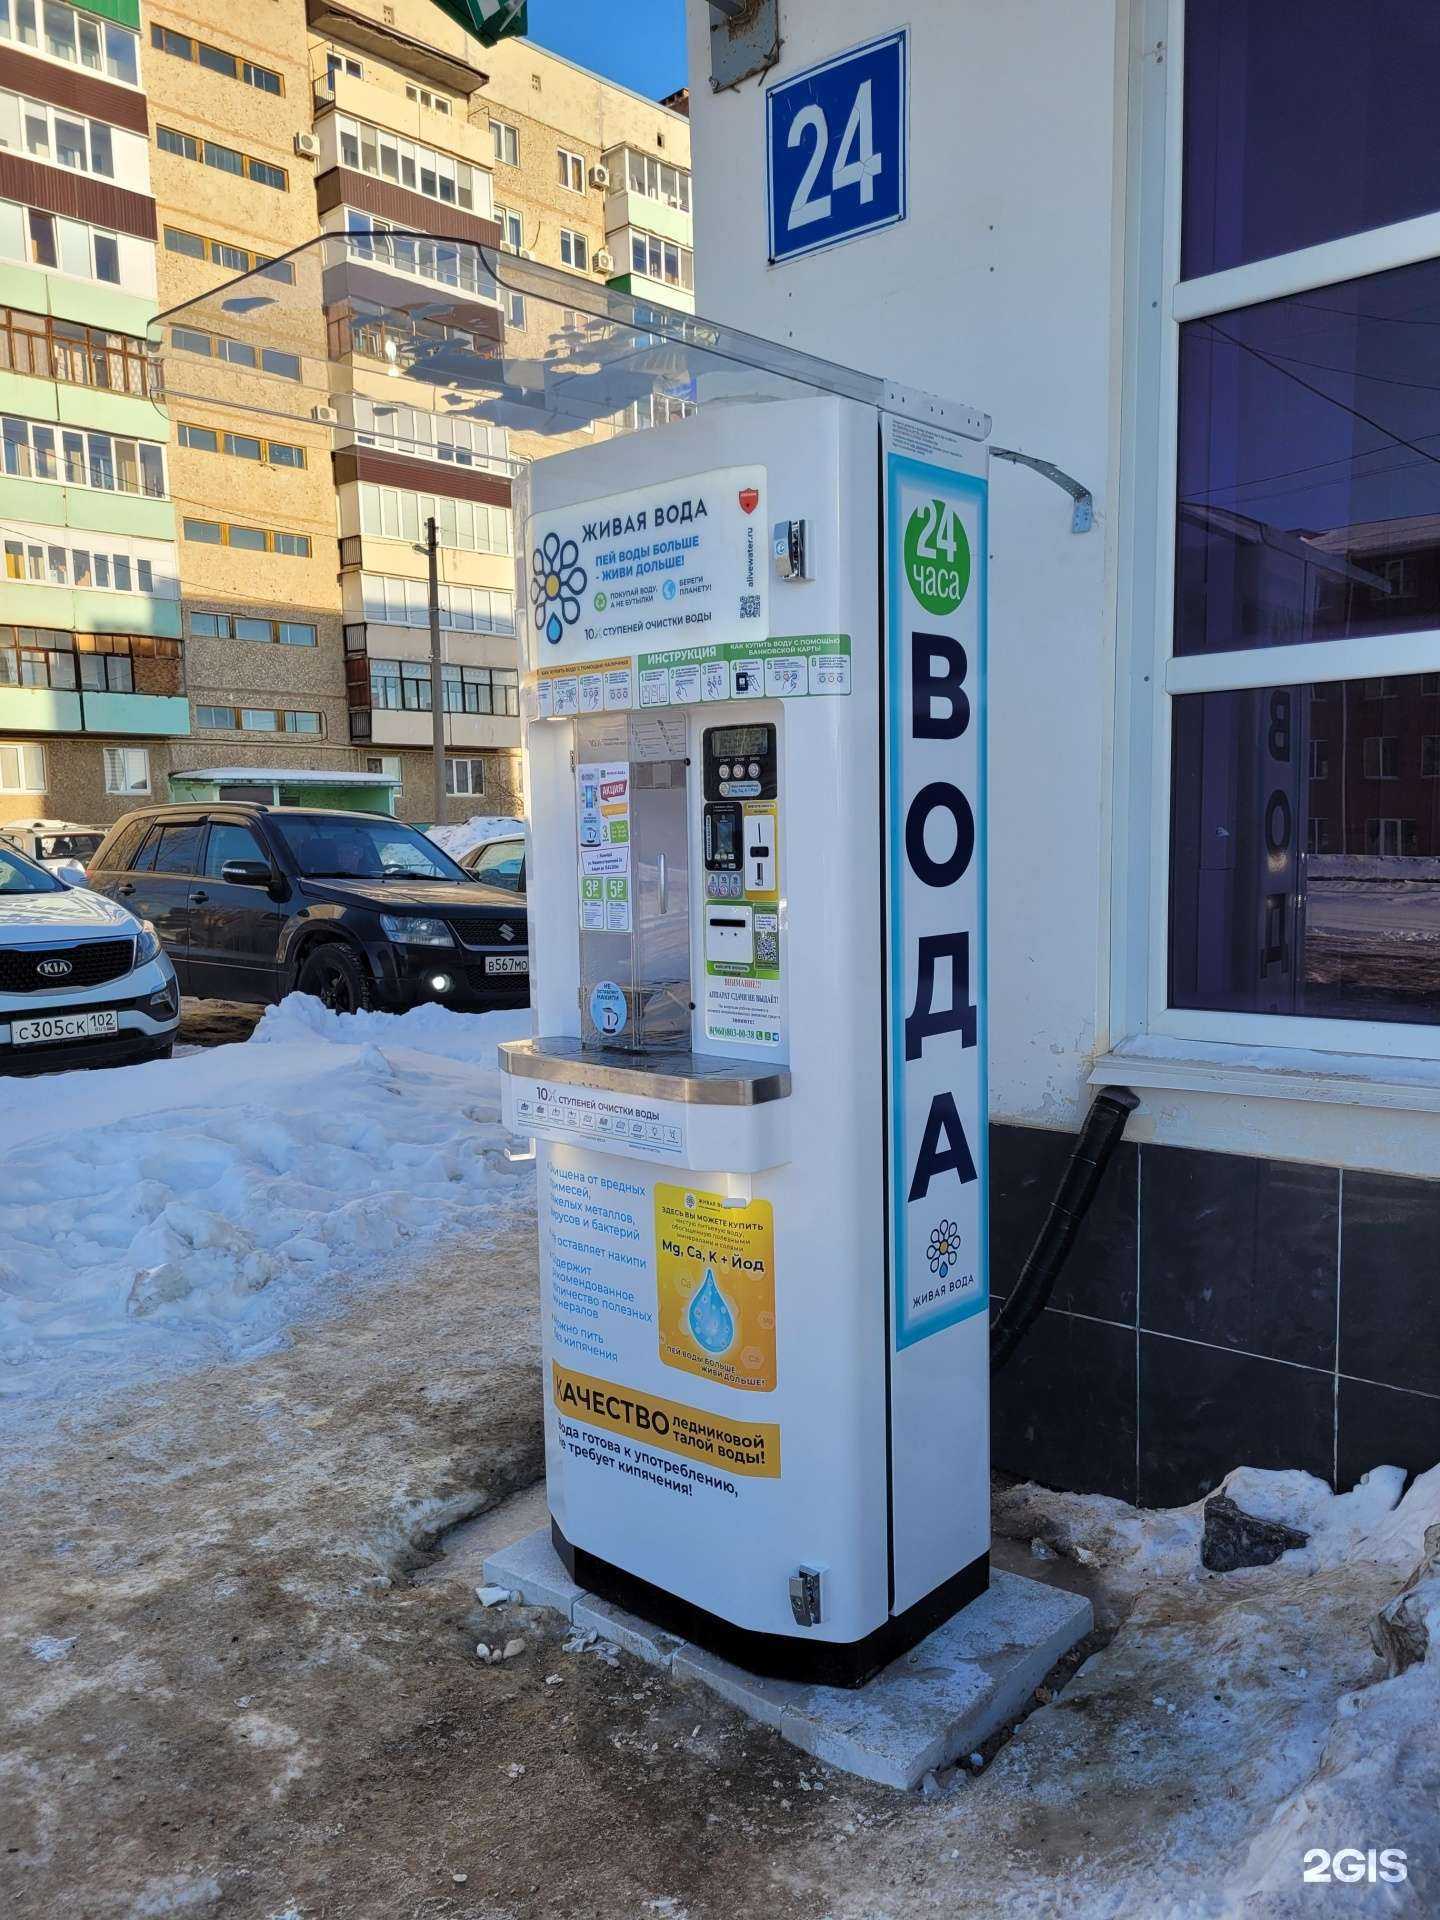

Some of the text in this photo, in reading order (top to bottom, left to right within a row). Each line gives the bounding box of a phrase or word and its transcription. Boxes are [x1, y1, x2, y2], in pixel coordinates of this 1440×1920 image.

[787, 78, 882, 232] 24
[582, 498, 708, 543] ЖИВАЯ ВОДА
[915, 499, 957, 563] 24
[595, 536, 700, 567] ПЕЙ ВОДЫ БОЛЬШЕ
[745, 527, 754, 588] alivewater.ru
[602, 567, 634, 582] ЖИВИ
[636, 556, 685, 577] ДОЛЬШЕ!
[679, 576, 704, 587] БЕРЕГИ
[913, 563, 961, 600] часа
[610, 588, 639, 600] ПОКУПАЙ
[617, 600, 624, 608] НЕ
[625, 595, 654, 607] БУТЫЛКИ
[679, 584, 712, 596] ПЛАНЕТУ!
[603, 622, 643, 637] СТУПЕНЕЙ
[645, 616, 684, 632] ОЧИСТКИ
[685, 612, 712, 624] ВОДЫ
[647, 646, 718, 665] ИНСТРУКЦИЯ
[745, 641, 772, 649] КУПИТЬ
[773, 640, 793, 648] ВОДУ
[800, 638, 841, 646] ПОМОЩЬЮ
[748, 645, 822, 656] БАНКОВСКОЙ КАРТЫ
[904, 631, 978, 1203] ВОДА
[44, 962, 68, 973] KIA
[89, 1013, 113, 1027] 102
[558, 1096, 596, 1110] СТУПЕНЕЙ
[599, 1102, 634, 1116] ОЧИСТКИ
[635, 1109, 660, 1121] ВОДЫ
[587, 1175, 598, 1184] от
[600, 1178, 646, 1196] вредных
[585, 1205, 636, 1226] металлов,
[661, 1206, 684, 1217] ЗДЕСЬ
[685, 1211, 696, 1220] ВЫ
[697, 1214, 728, 1227] МОЖЕТЕ
[728, 1220, 764, 1231] КУПИТЬ
[591, 1219, 640, 1240] бактерий
[558, 1237, 647, 1269] оставляет накипи
[662, 1239, 765, 1272] Mg, Ca, K + Йод
[912, 1274, 974, 1309] ЖИВАЯ ВОДА
[602, 1300, 653, 1324] полезных
[580, 1328, 604, 1344] пить
[564, 1337, 618, 1362] кипячения
[666, 1345, 681, 1355] ПЕЙ
[704, 1358, 736, 1374] БОЛЬШЕ
[701, 1366, 723, 1377] ЖИВИ
[556, 1375, 765, 1449] КАЧЕСТВО ледниковой
[673, 1430, 766, 1465] талой воды!
[568, 1443, 615, 1469] требует
[618, 1459, 694, 1497] кипячения!
[582, 1431, 621, 1455] готова
[624, 1447, 631, 1458] к
[634, 1450, 739, 1498] употреблению,
